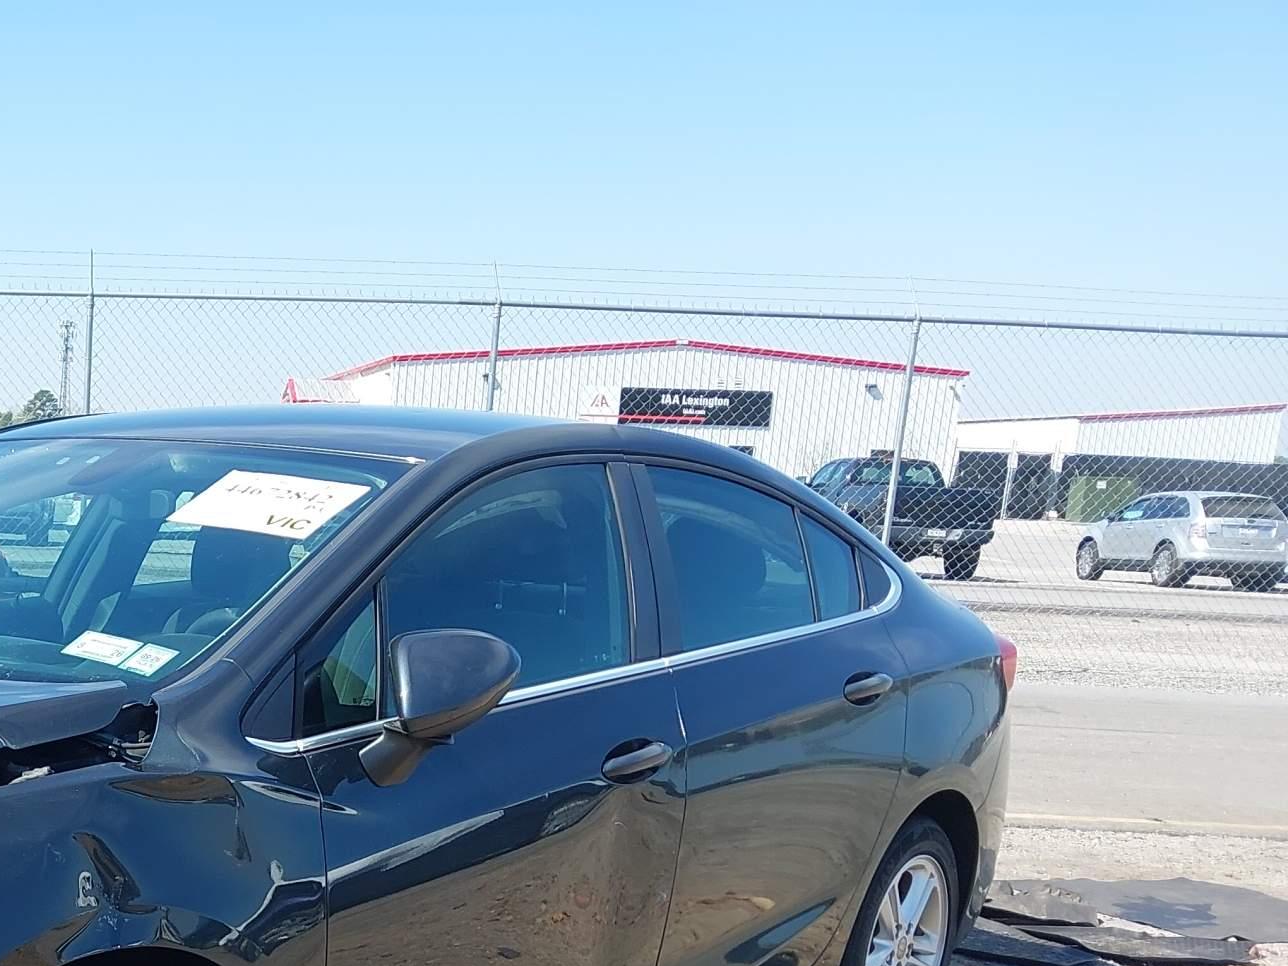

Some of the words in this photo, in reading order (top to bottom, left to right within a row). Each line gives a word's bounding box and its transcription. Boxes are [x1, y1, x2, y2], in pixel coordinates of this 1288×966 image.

[661, 394, 680, 405] IAA
[682, 395, 730, 408] Lexington
[266, 515, 311, 530] VIC
